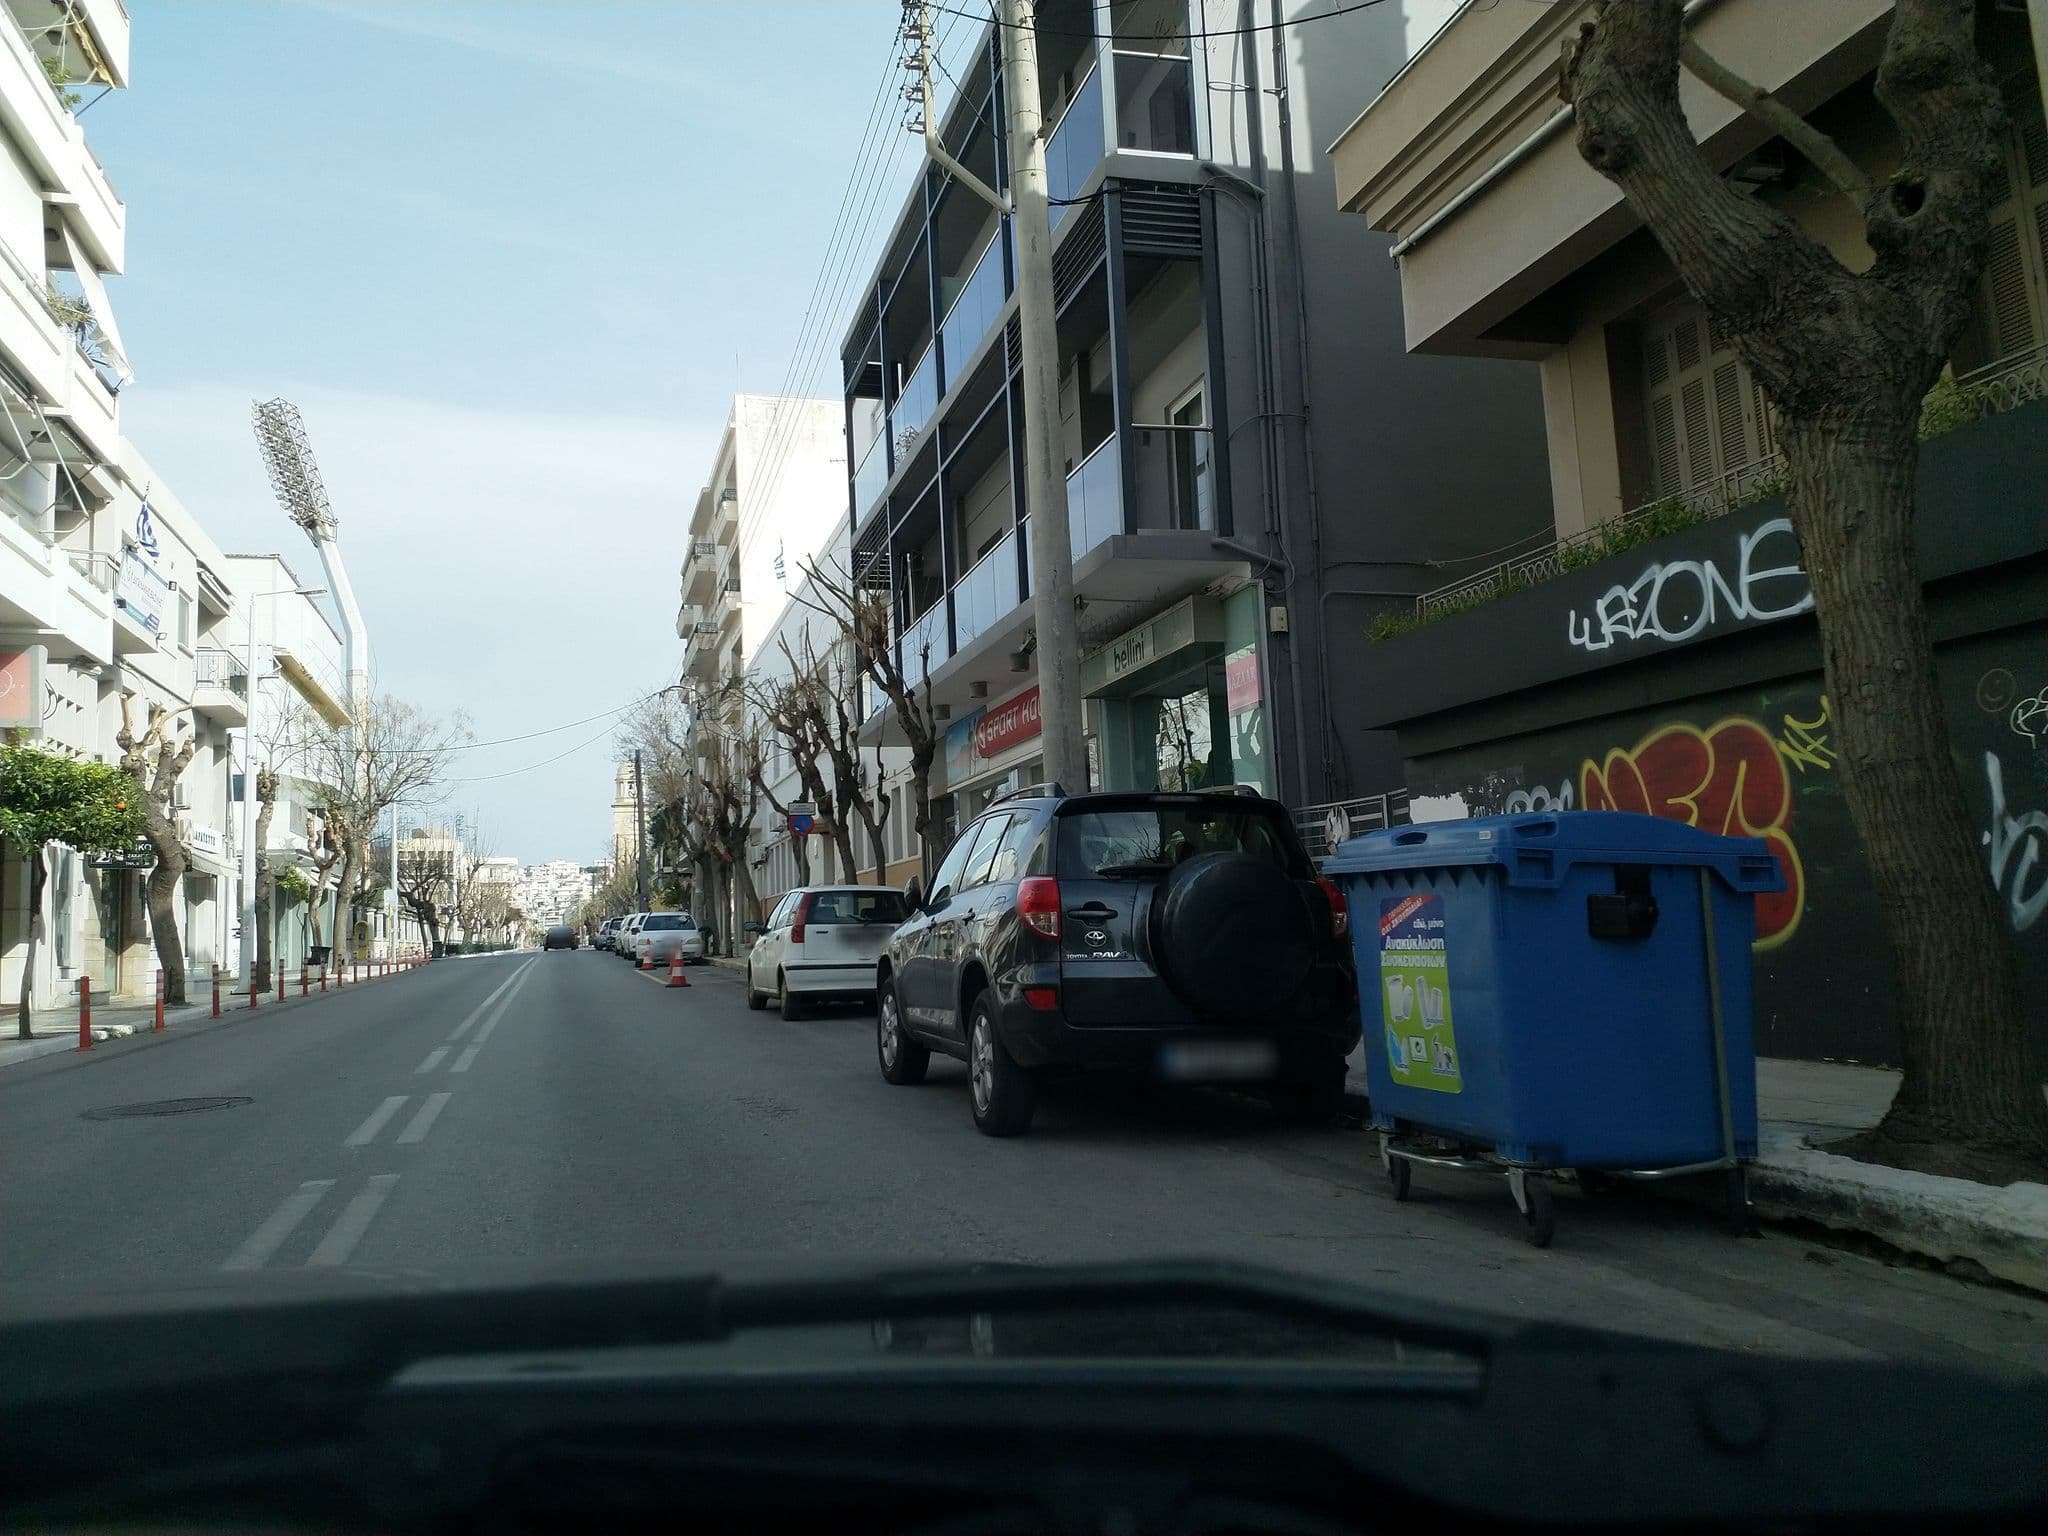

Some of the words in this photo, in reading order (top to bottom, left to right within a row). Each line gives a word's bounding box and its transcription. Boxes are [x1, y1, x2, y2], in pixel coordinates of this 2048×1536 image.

[1114, 632, 1145, 673] bellini
[987, 706, 1019, 741] SPORT
[1385, 935, 1444, 950] Ανακύκλωση
